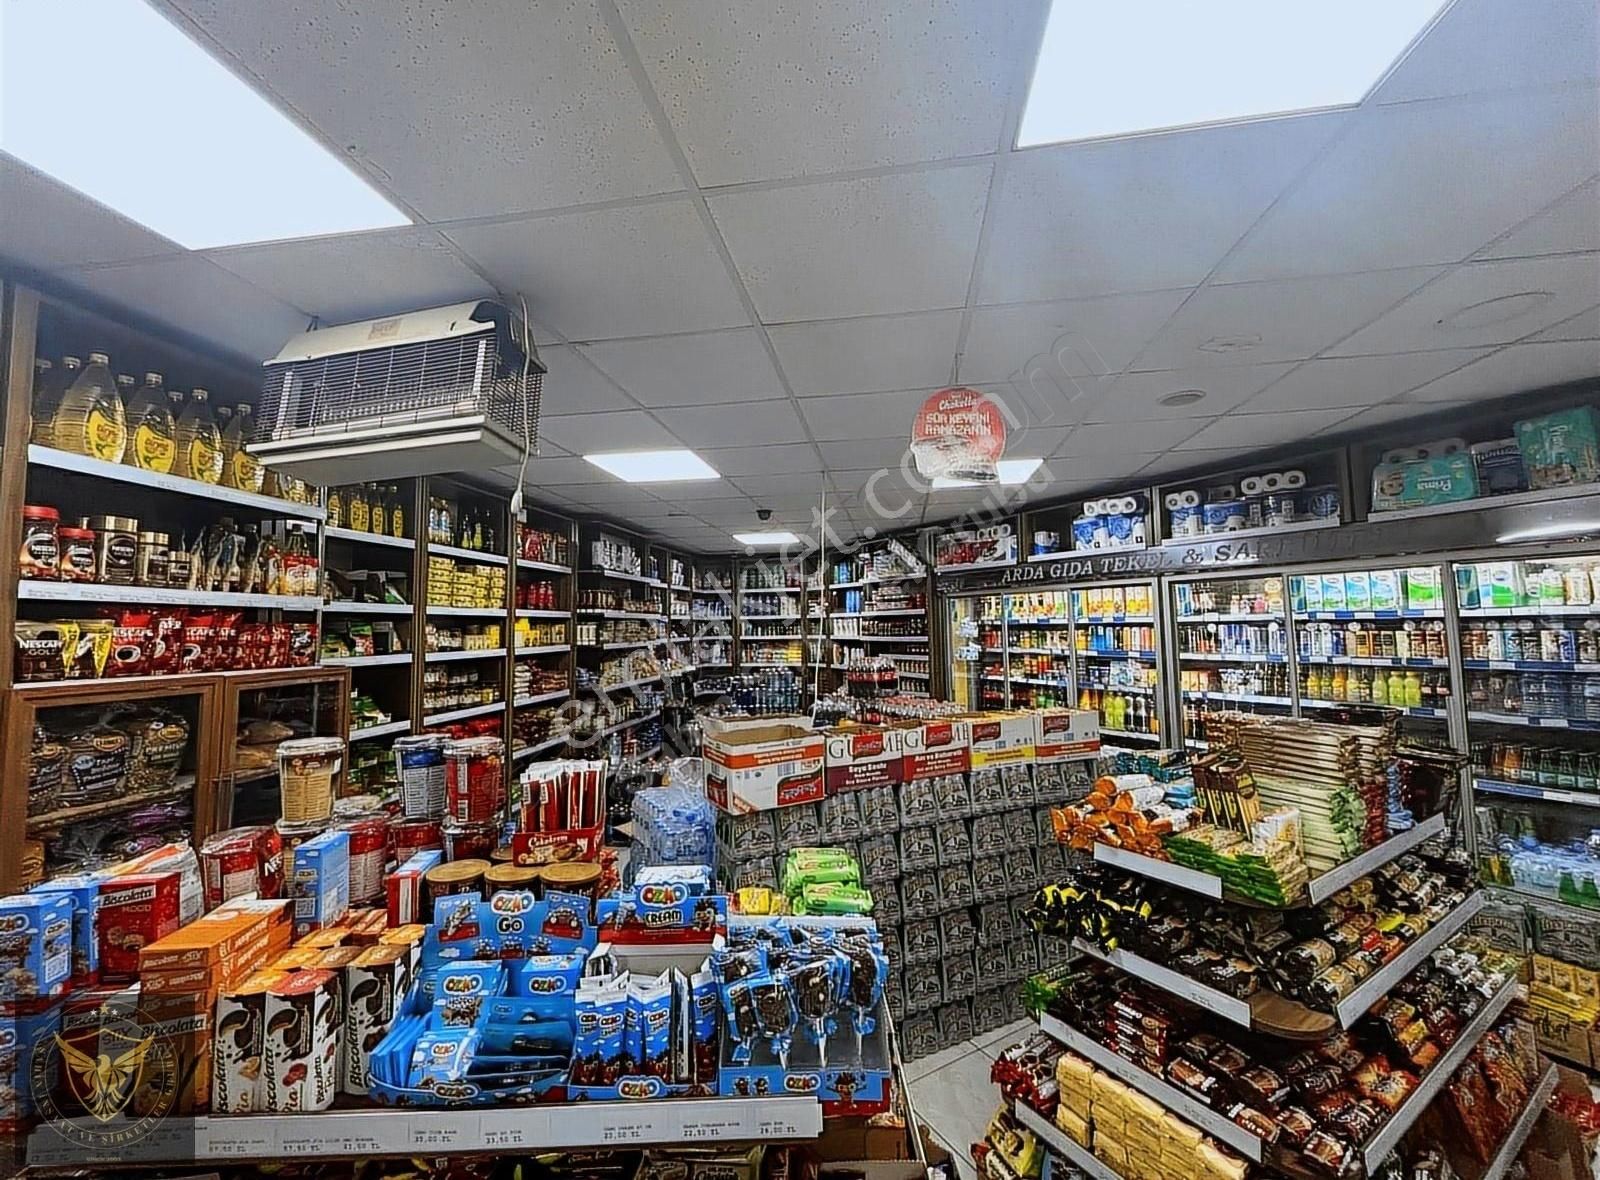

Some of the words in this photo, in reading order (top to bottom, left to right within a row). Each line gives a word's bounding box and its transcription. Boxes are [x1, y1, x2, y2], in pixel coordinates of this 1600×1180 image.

[1417, 479, 1452, 492] Prima
[1001, 567, 1044, 584] ARDA
[1050, 561, 1093, 578] GIDA
[1100, 552, 1174, 573] TEKEL
[1182, 549, 1205, 564] &
[102, 888, 153, 906] Biscolata
[646, 909, 683, 924] CREAM
[142, 1018, 205, 1037] Biscolata
[349, 1012, 364, 1088] Biscolata
[214, 1045, 229, 1113] iscolata
[265, 1045, 279, 1113] iscolata
